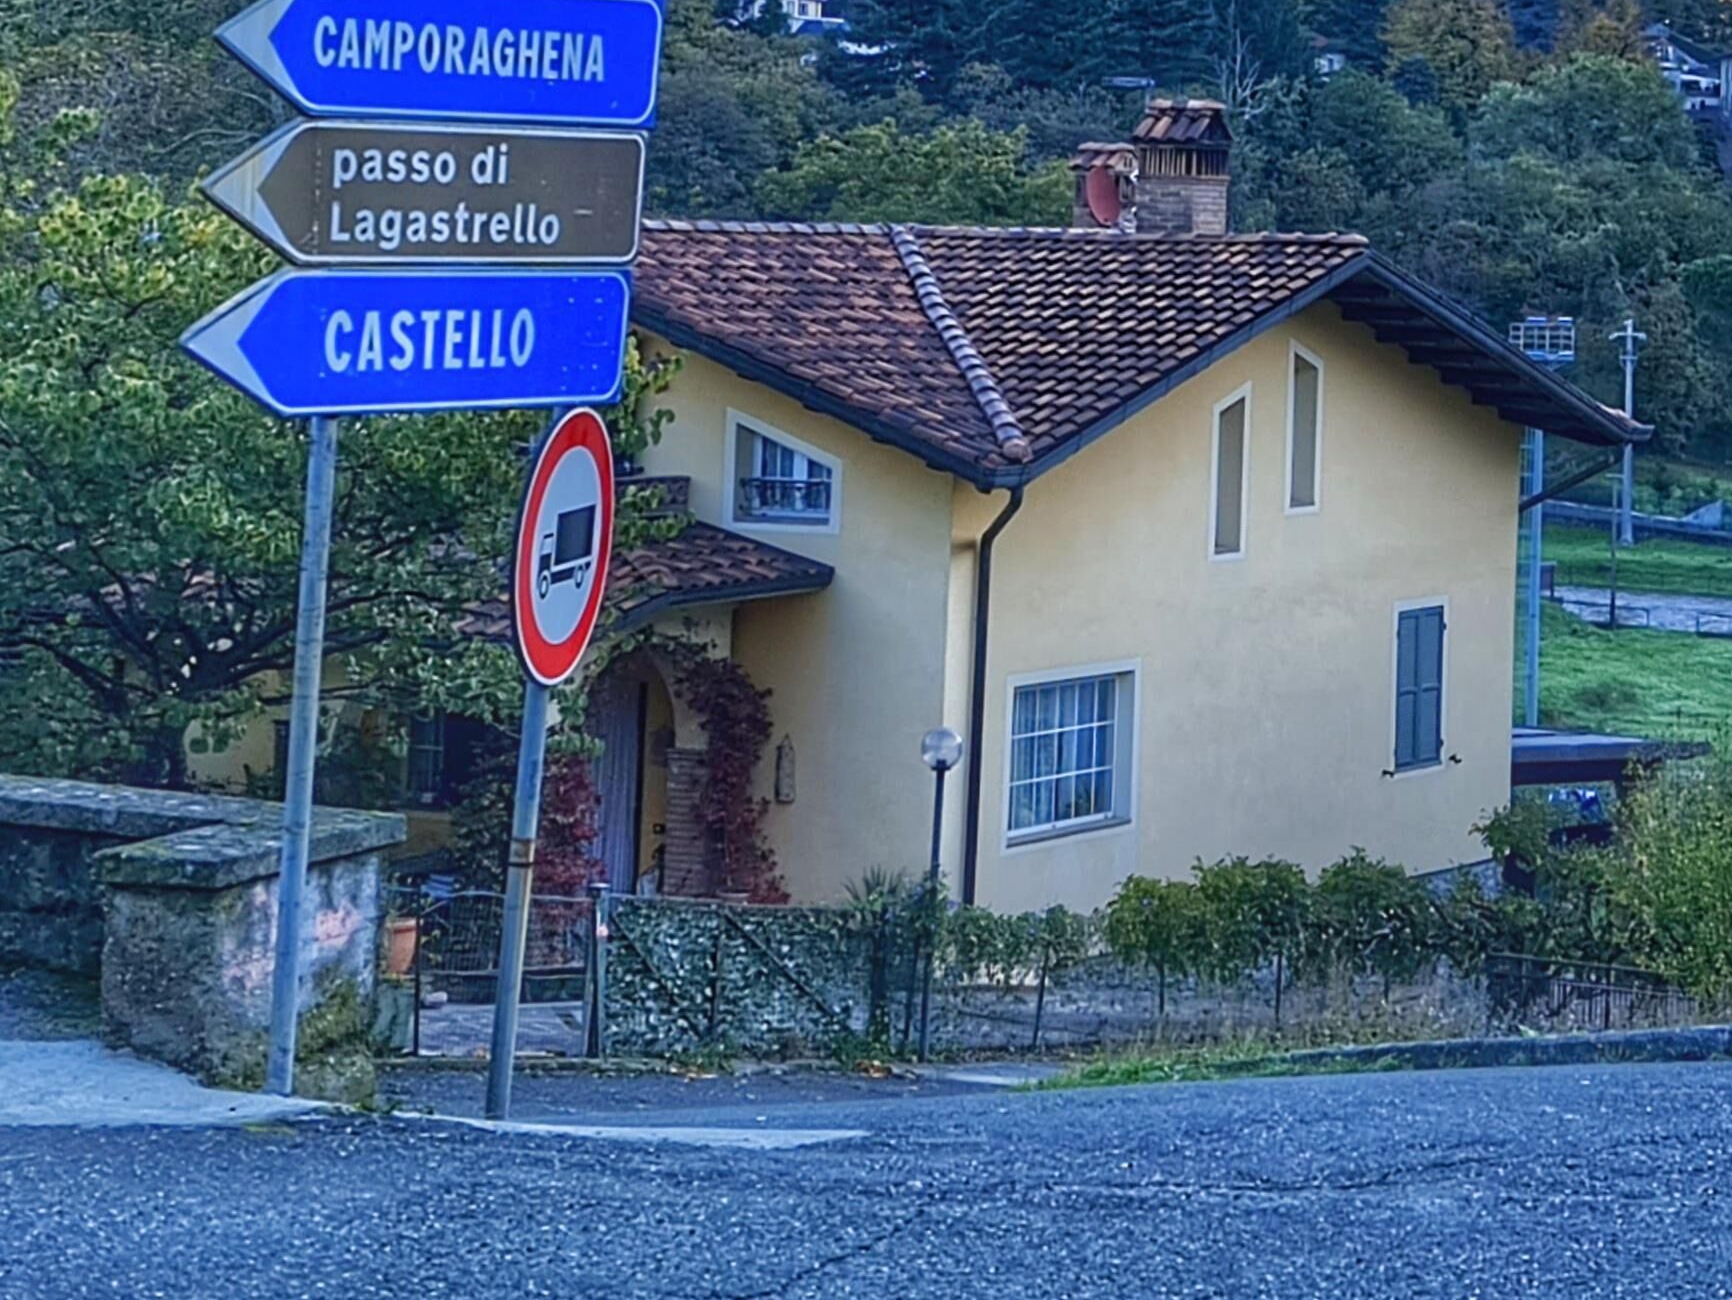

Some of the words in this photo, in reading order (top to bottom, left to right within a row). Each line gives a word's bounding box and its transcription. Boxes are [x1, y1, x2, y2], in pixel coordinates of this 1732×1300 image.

[314, 15, 605, 83] CAMPORAGHENA
[333, 148, 458, 189] passo
[471, 143, 510, 185] di
[330, 203, 561, 251] Lagastrello
[323, 308, 536, 373] CASTELLO
